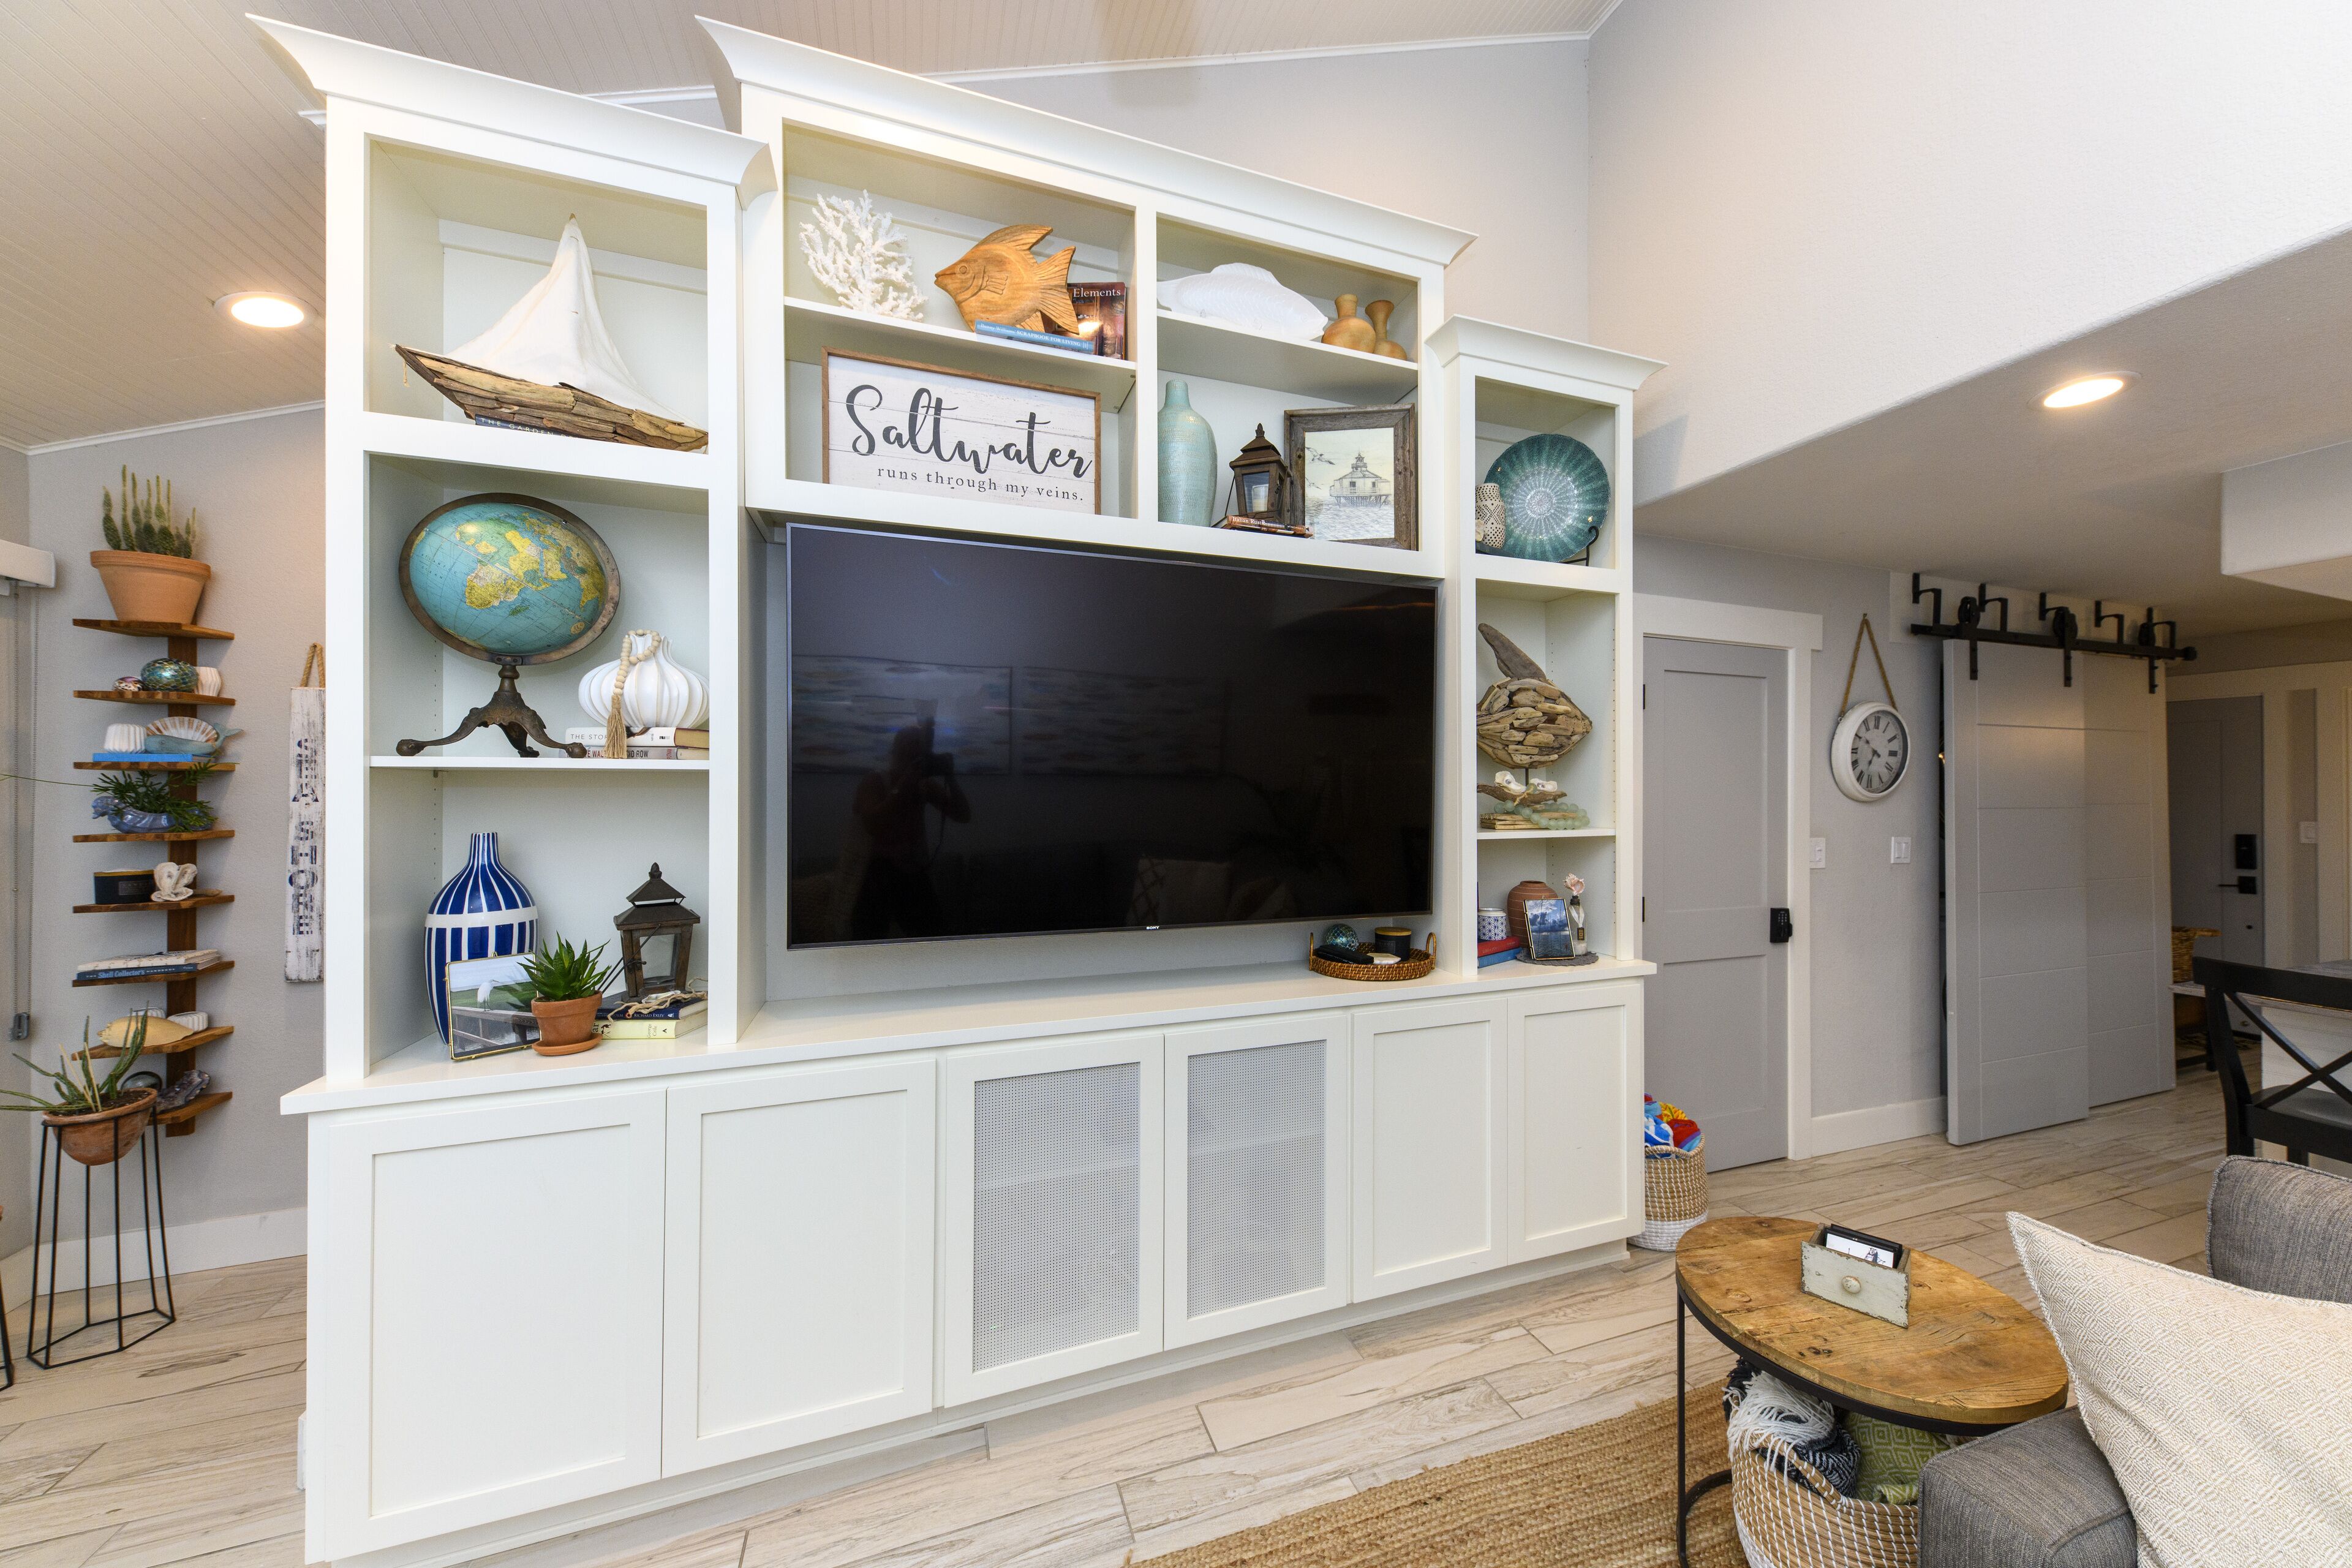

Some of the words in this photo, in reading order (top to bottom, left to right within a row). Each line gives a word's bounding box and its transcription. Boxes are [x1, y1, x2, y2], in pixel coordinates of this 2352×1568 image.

[1073, 288, 1121, 298] Elements
[1017, 330, 1049, 341] SCRAPBOOK
[481, 418, 501, 426] THE
[509, 424, 554, 435] GARDEN
[846, 385, 1093, 478] Saltwater
[878, 467, 918, 481] runs
[926, 471, 997, 492] through
[1006, 484, 1028, 497] my
[1037, 486, 1084, 501] veins.
